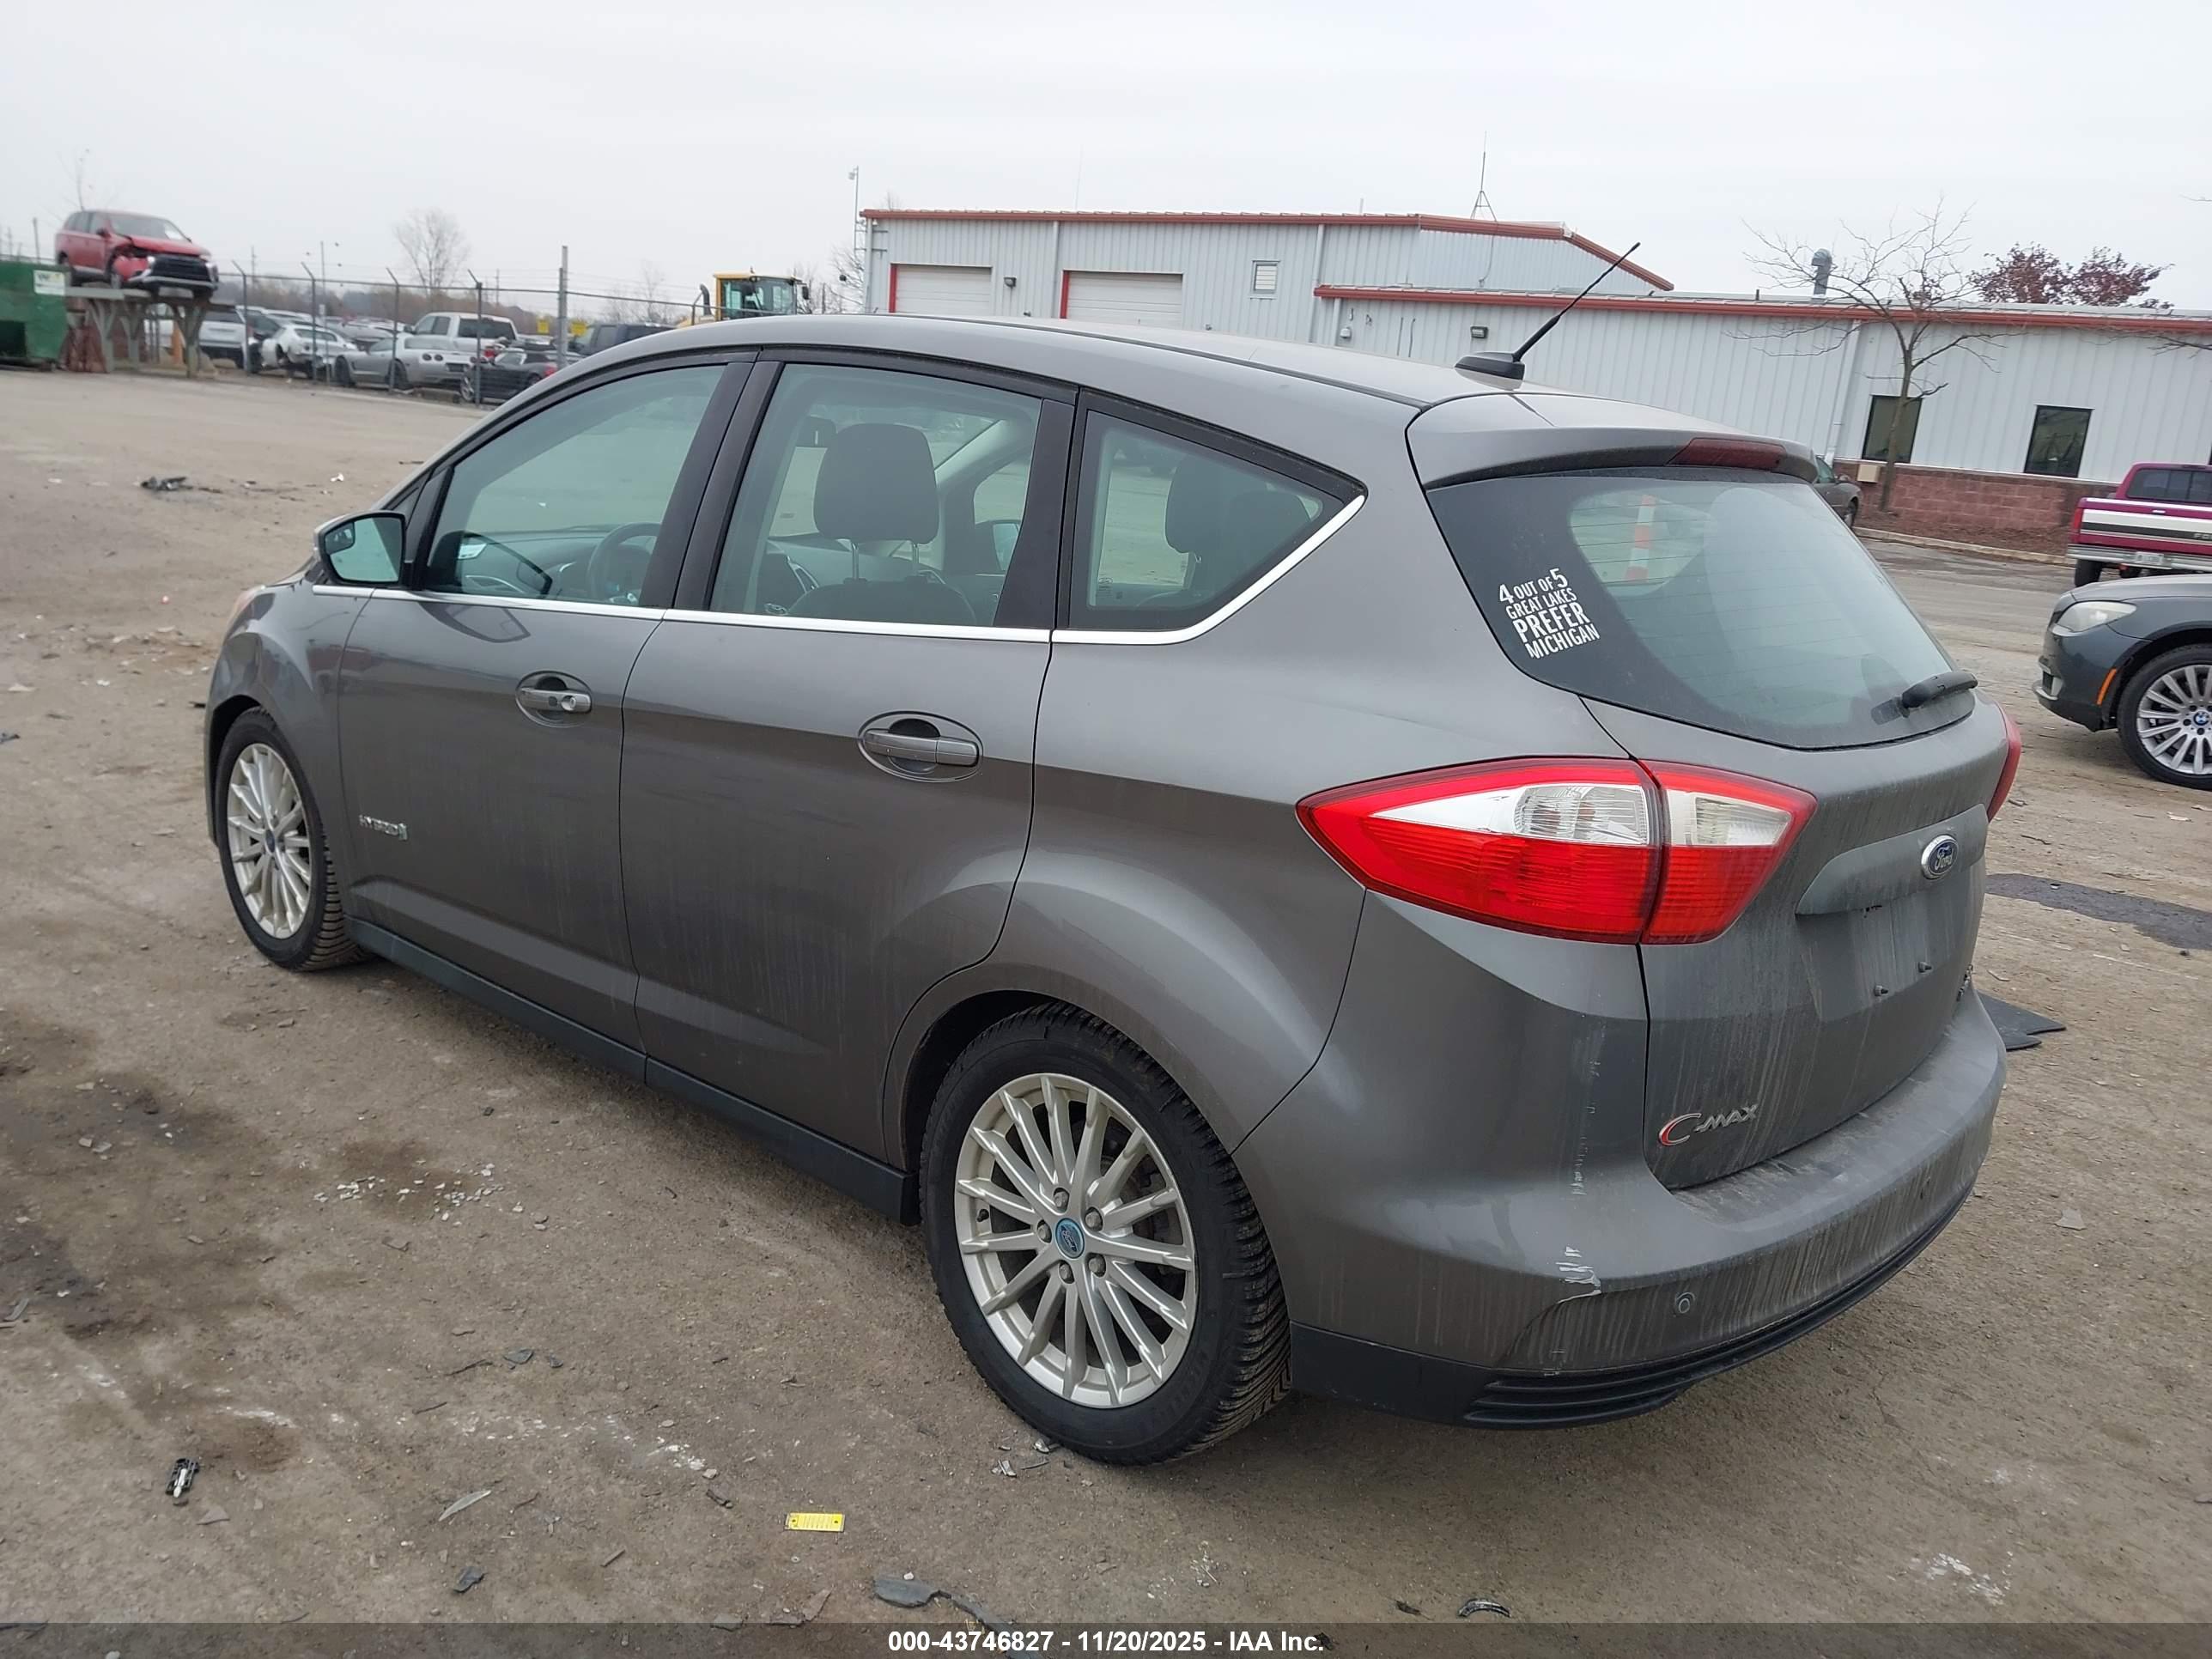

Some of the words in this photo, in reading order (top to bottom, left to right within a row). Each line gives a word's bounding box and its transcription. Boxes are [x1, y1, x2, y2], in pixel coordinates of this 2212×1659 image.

[1499, 584, 1514, 604] 4
[1513, 580, 1539, 599] OUT
[1537, 576, 1554, 592] OF
[1549, 568, 1568, 588] 5
[1505, 597, 1543, 620] GREAT
[1541, 587, 1577, 608] LAKES
[1512, 602, 1591, 643] PREFER
[1524, 623, 1601, 659] MICHIGAN
[1658, 1103, 1758, 1146] C-MAX
